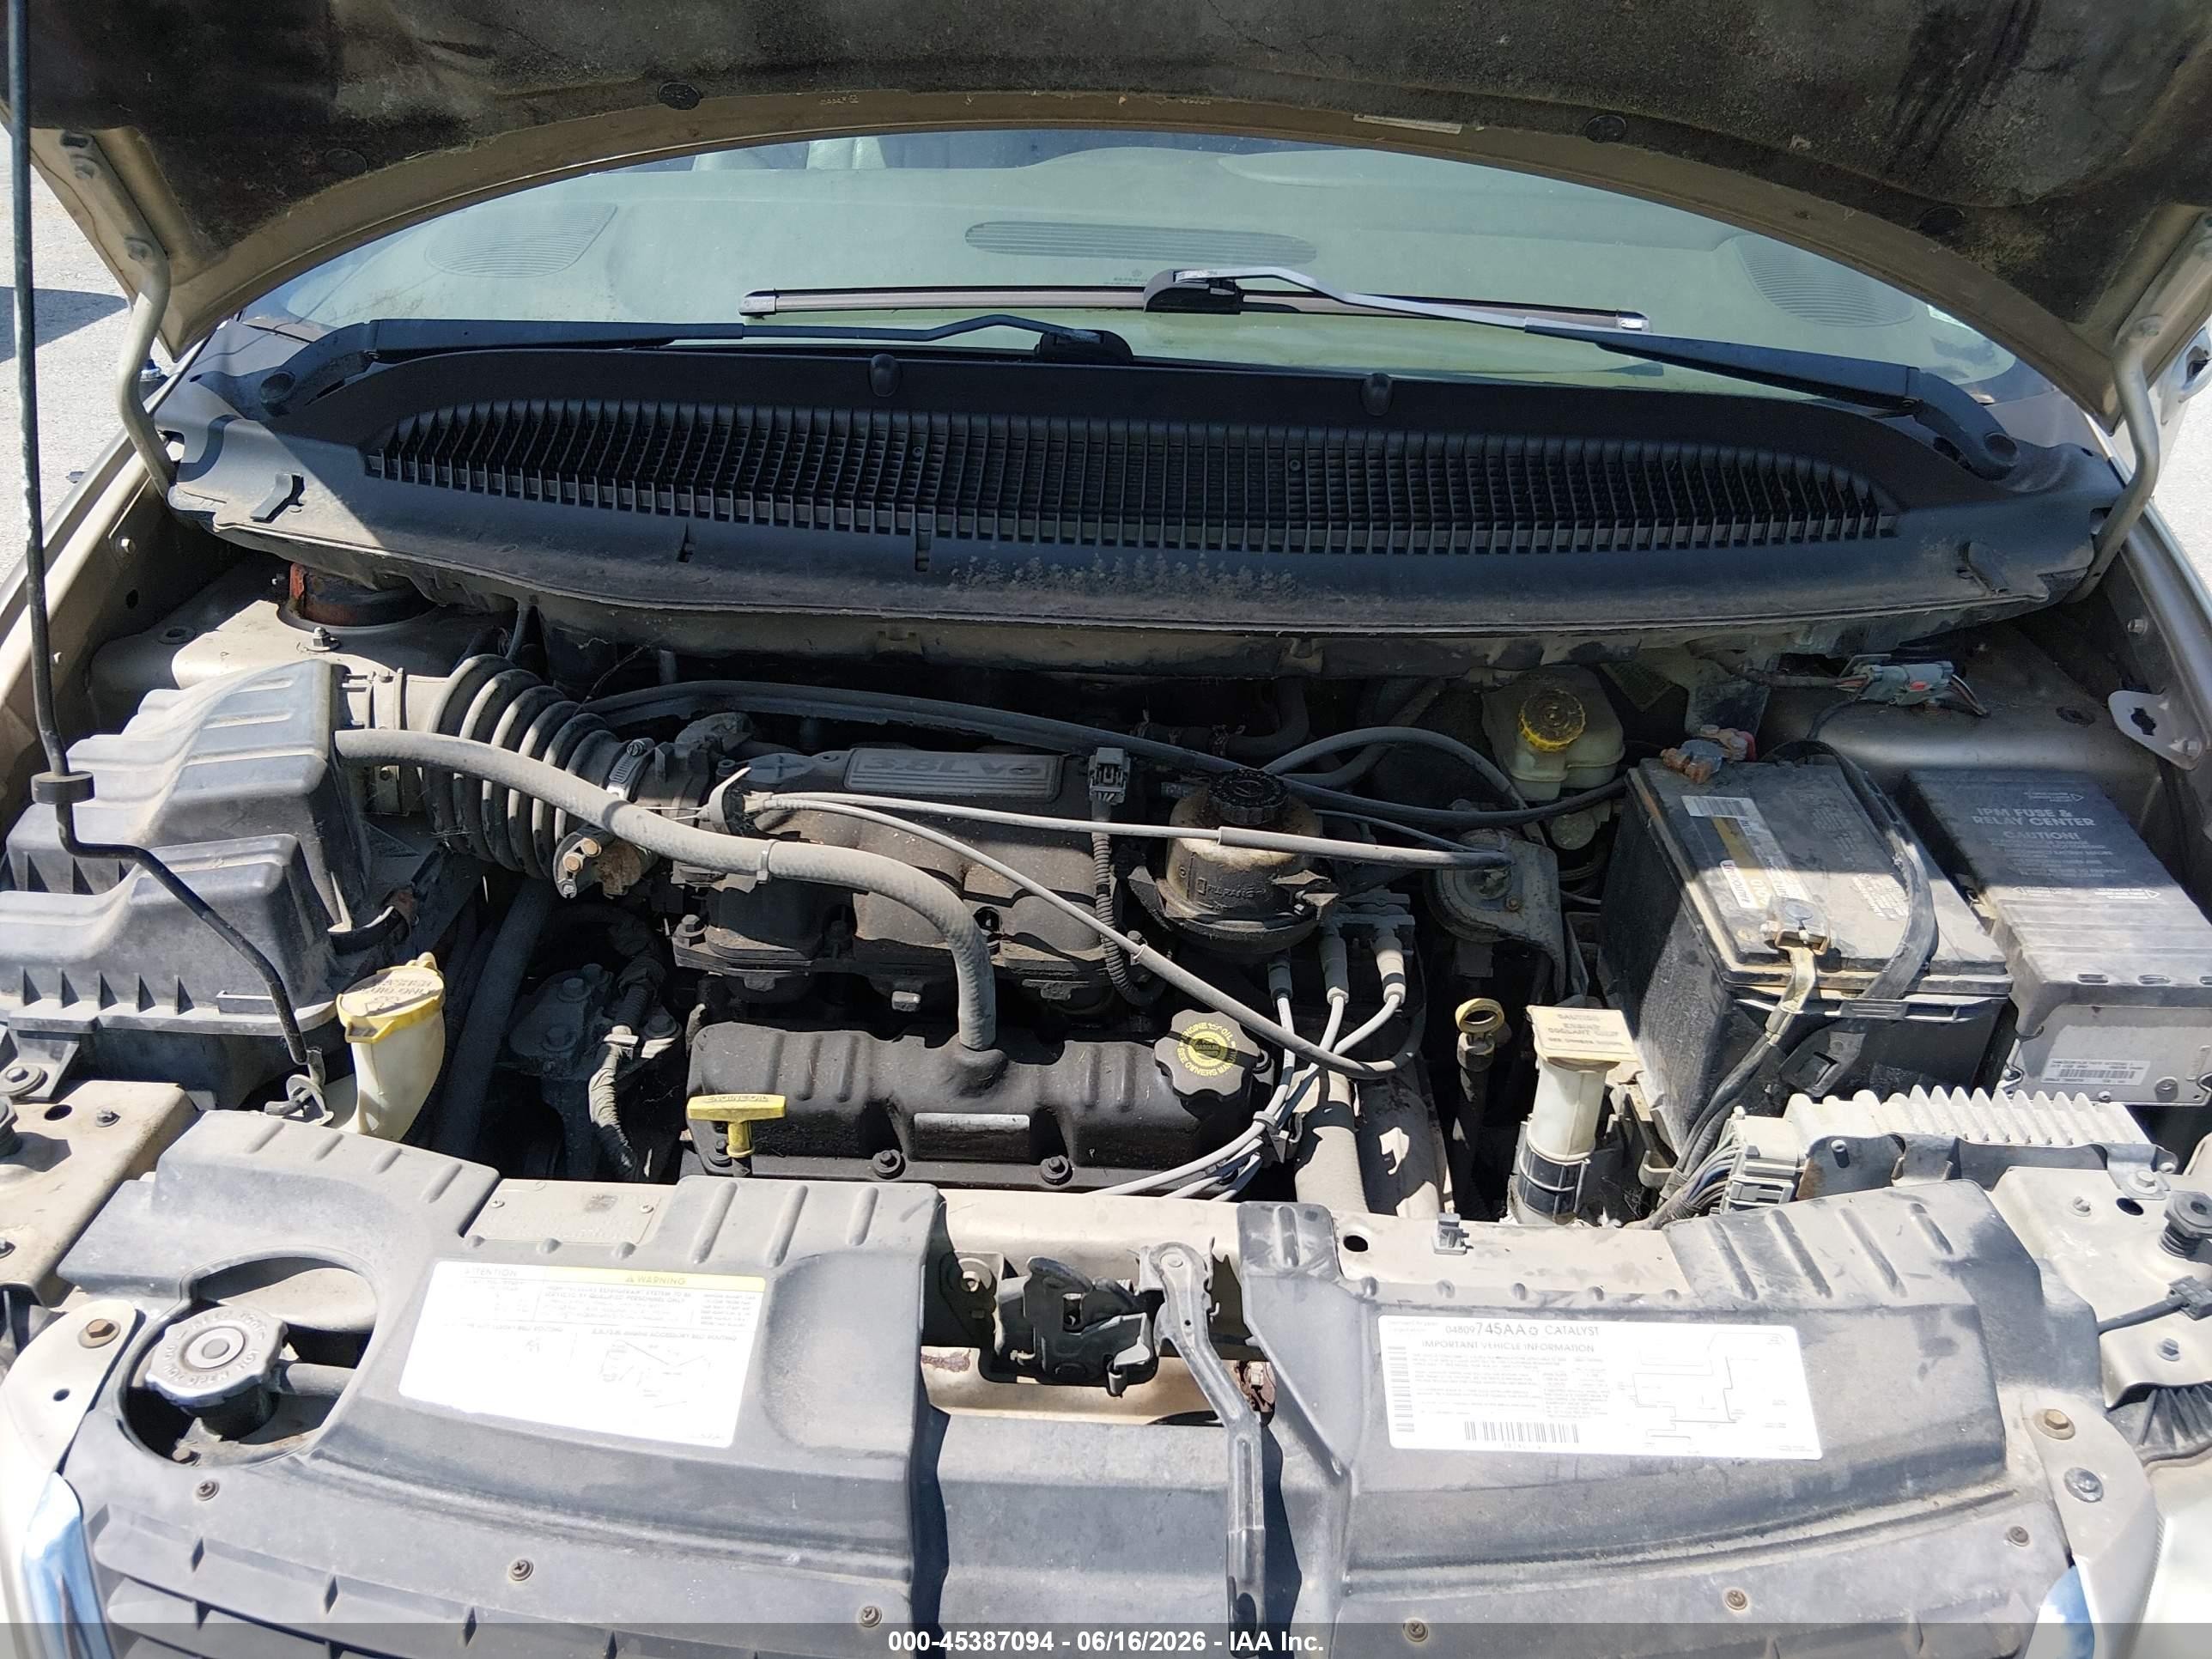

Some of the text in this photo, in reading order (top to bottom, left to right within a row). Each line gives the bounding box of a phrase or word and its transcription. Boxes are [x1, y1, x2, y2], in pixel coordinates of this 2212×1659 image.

[1976, 807, 2074, 818] IPM FUSE &
[1971, 816, 2097, 826] RELAY CENTER
[2002, 830, 2081, 840] CAUTION!
[1182, 1022, 1234, 1042] ENGINE OIL
[1176, 1047, 1189, 1064] SEE
[1185, 1060, 1218, 1077] OWNERS
[637, 1276, 687, 1285] WARNING
[1544, 1325, 1600, 1336] CATALYST
[1421, 1340, 1595, 1353] IMPORTANT VEHICLE INFORMATION
